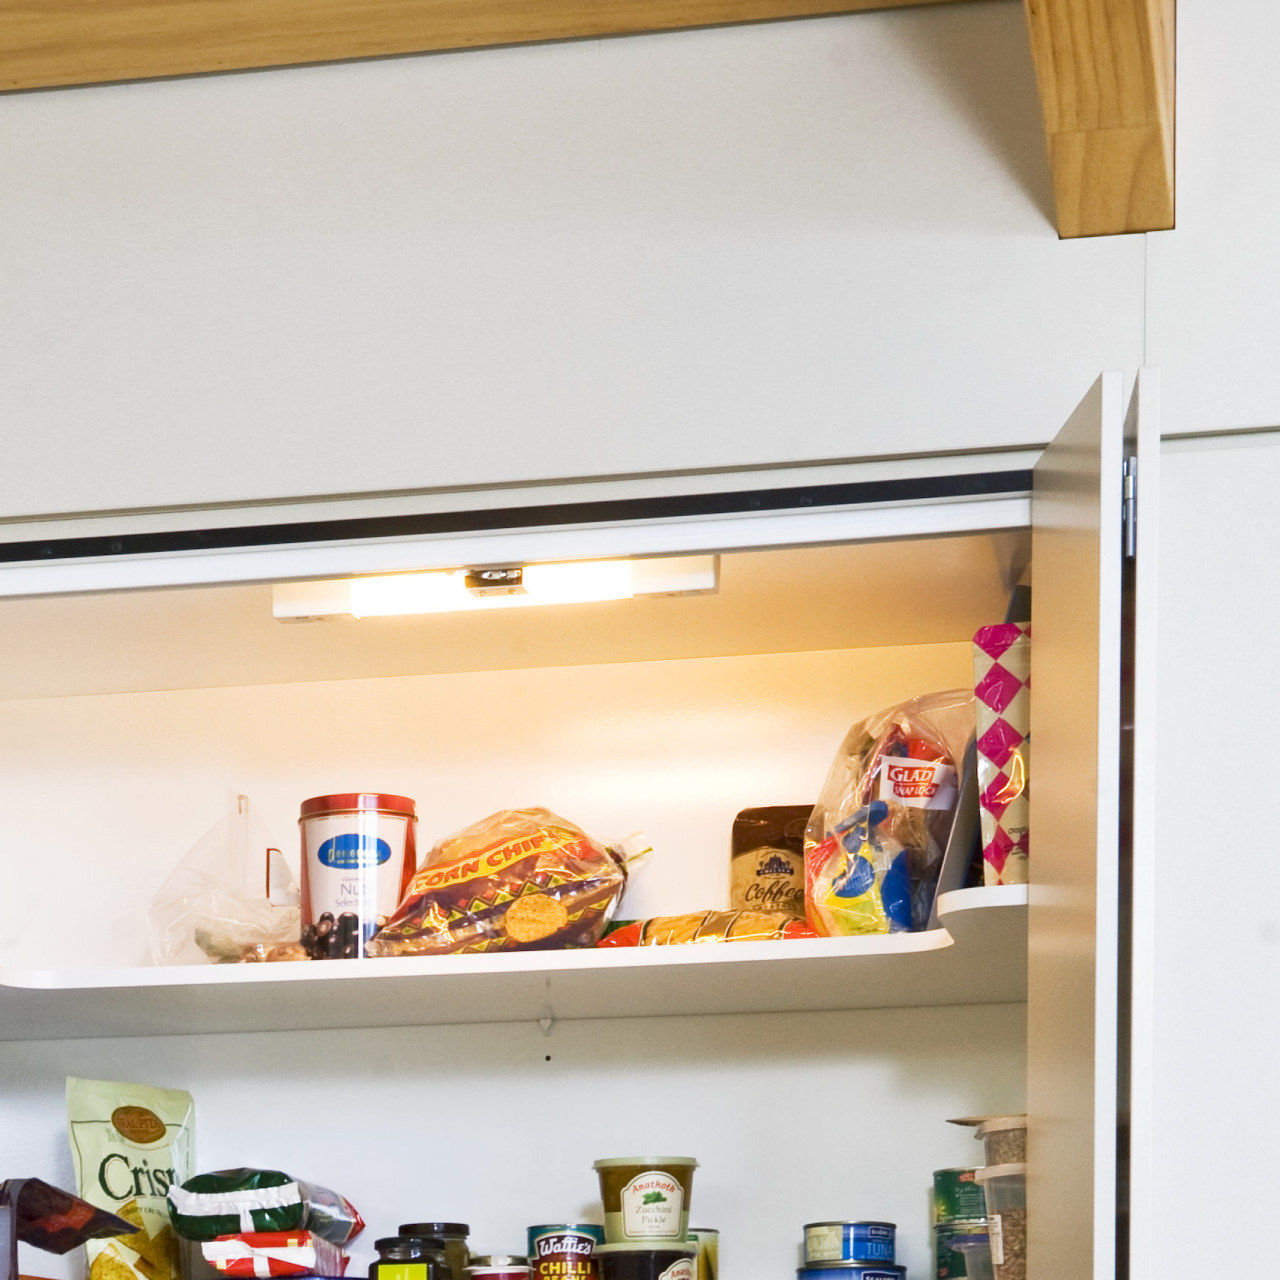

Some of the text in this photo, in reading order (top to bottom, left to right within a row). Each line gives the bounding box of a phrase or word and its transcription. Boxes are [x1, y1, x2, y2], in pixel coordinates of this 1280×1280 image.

[890, 767, 931, 783] GLAD
[414, 861, 480, 888] CORN
[745, 880, 803, 903] Coffee
[539, 1235, 593, 1256] Wattie's
[539, 1261, 592, 1275] CHILLI
